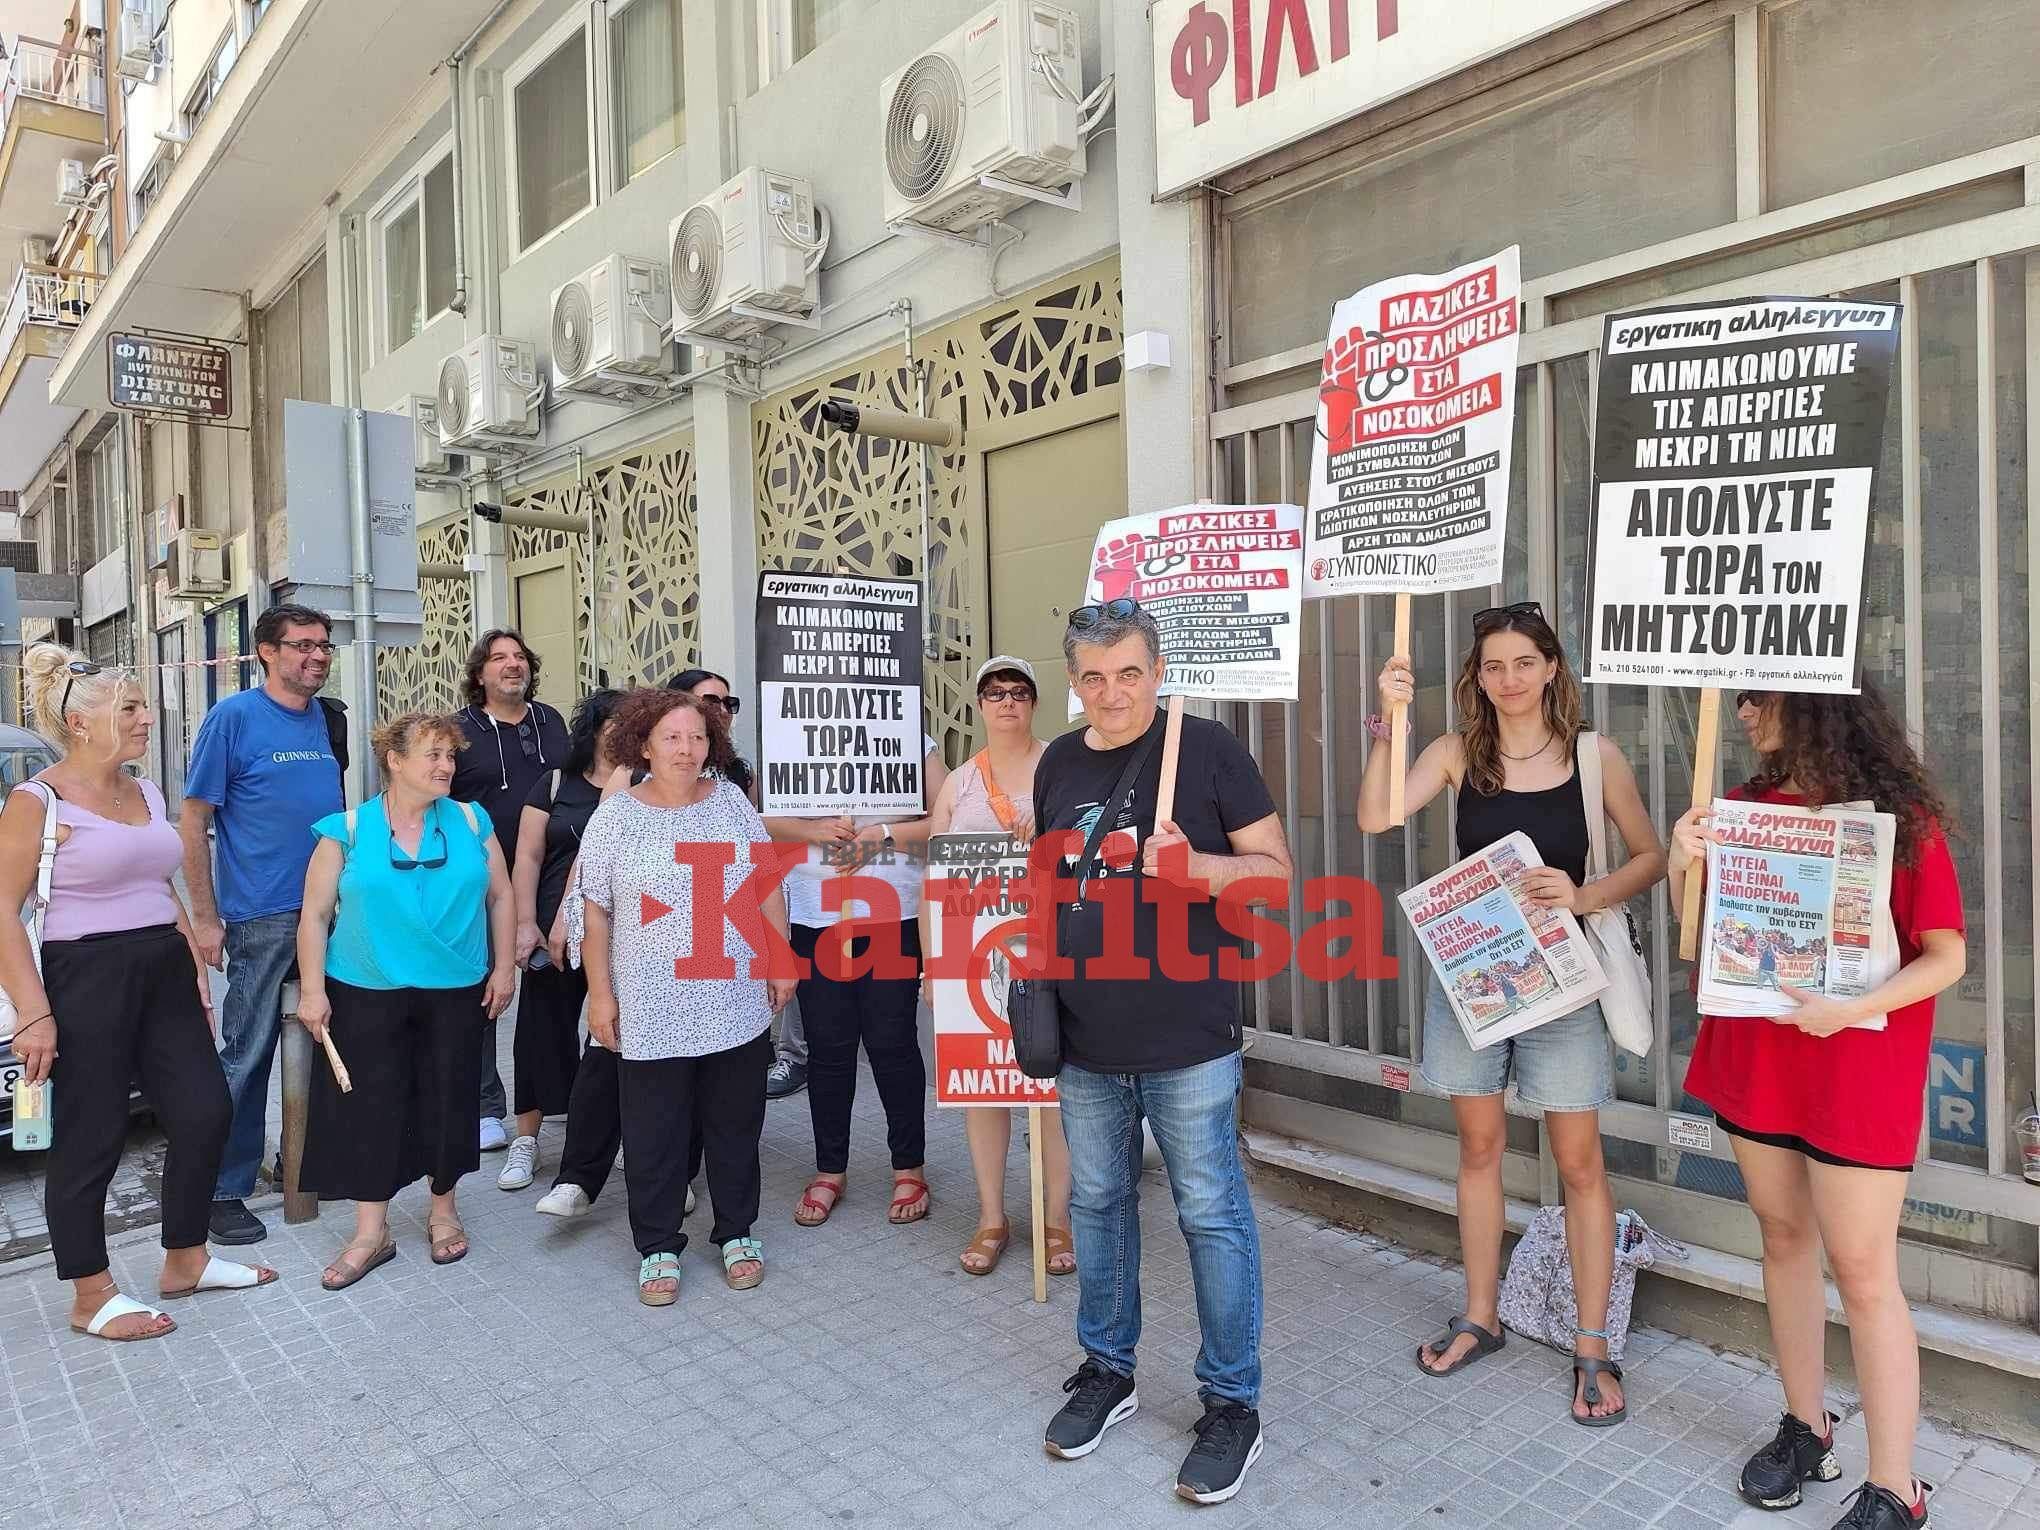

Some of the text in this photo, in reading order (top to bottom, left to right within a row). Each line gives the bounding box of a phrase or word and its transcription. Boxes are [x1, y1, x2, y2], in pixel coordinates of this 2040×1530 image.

[1388, 273, 1491, 328] ΜΑΖΙΚΕΣ
[1364, 305, 1512, 371] ΠΡΟΣΛΗΨΕΙΣ
[1616, 306, 1886, 348] εργατικη αλληλεγγυη
[116, 343, 223, 371] ΦΛΑΝΤΖΕΣ
[1630, 342, 1858, 394] ΚΛΙΜΑΚΩΝΟΥΜΕ
[128, 362, 217, 383] ΑΥΤΟΚΙΝΗΤΩΝ
[1421, 368, 1455, 394] ΣΤΑ
[120, 374, 223, 399] DIHTUNG
[129, 391, 213, 410] ZA KOLA
[1362, 383, 1493, 435] ΝΟΣΟΚΟΜΕΙΑ
[1653, 384, 1826, 430] ΤΙΣ ΑΠΕΡΓΙΕΣ
[1331, 430, 1460, 467] ΜΟΝΙΜΟΠΟΙΗΣΗ ΟΛΩΝ
[1635, 423, 1837, 469] ΜΕΧΡΙ ΤΗ ΝΙΚΗ
[1331, 447, 1452, 480] ΤΩΝ ΣΥΜΒΑΣΙΟΥΧΩΝ
[1343, 456, 1496, 498] ΑΥΞΗΣΕΙΣ ΣΤΟΥΣ ΜΙΣΘΟΥΣ
[1320, 483, 1476, 524] ΚΡΑΤΙΚΟΠΟΙΗΣΗ ΟΛΩΝ ΤΩΝ
[1320, 496, 1481, 537] ΙΔΙΩΤΙΚΩΝ ΝΟΣΗΛΕΥΤΗΡΙΩΝ
[1626, 477, 1835, 537] ΑΠΟΛΥΣΤΕ
[1168, 513, 1270, 534] ΜΑΖΙΚΕΣ
[1347, 516, 1486, 550] ΑΡΣΗ ΤΩΝ ΑΝΑΣΤΟΛΩΝ
[1144, 533, 1294, 560] ΠΡΟΣΛΗΨΕΙΣ
[1196, 556, 1233, 569] ΣΤΑ
[1328, 553, 1436, 579] ΣΥΝΤΟΝΙΣΤΙΚΟ
[1660, 543, 1822, 595] ΤΩΡΑ ΤΟΝ
[767, 578, 914, 603] εργατικη αλληλεγγυη
[1141, 572, 1280, 597] ΝΟΣΟΚΟΜΕΙΑ
[1140, 595, 1242, 611] ΜΟΠΟΙΗΣΗ ΟΛΩΝ
[1151, 603, 1233, 618] ΜΒΑΣΙΟΥΧΩΝ
[776, 606, 905, 632] ΚΛΙΜΑΚΩΝΟΥΜΕ
[1157, 614, 1284, 630] ΕΙΣ ΣΤΟΥΣ ΜΙΣΘΟΥΣ
[1601, 604, 1848, 657] ΜΗΤΣΟΤΑΚΗ
[792, 630, 892, 654] ΤΙΣ ΑΠΕΡΓΙΕΣ
[1160, 638, 1267, 651] ΝΟΣΗΛΕΥΤΗΡΙΩΝ
[1193, 631, 1229, 640] ΟΛΩΝ
[1234, 629, 1260, 638] ΤΩΝ
[783, 655, 900, 678] ΜΕΧΡΙ ΤΗ ΝΙΚΗ
[1192, 650, 1274, 662] ΑΝΑΣΤΟΛΩΝ
[1164, 668, 1215, 685] ΙΣΤΙΚΟ
[1616, 664, 1630, 673] 210
[1632, 665, 1664, 675] 5241001
[1673, 667, 1738, 679] www.ergatiki.gr
[781, 687, 903, 720] ΑΠΟΛΥΣΤΕ
[803, 725, 902, 757] ΤΩΡΑ ΤΟΝ
[272, 750, 320, 763] GUINNESS
[769, 762, 917, 795] ΜΗΤΣΟΤΑΚΗ
[1748, 813, 1836, 837] εργατικη
[1717, 826, 1835, 855] αλληλεγγυη
[1720, 853, 1768, 872] Η ΥΓΕΙΑ
[1428, 860, 1489, 898] εργατικη
[1720, 868, 1742, 883] ΔΕΝ
[1747, 871, 1784, 888] ΕΙΝΑΙ
[1414, 873, 1499, 924] αλληλεγγυη
[1719, 883, 1800, 905] ΕΜΠΟΡΕΥΜΑ
[1427, 915, 1467, 941] Η ΥΓΕΙΑ
[1434, 920, 1484, 952] ΔΕΝ ΕΙΝΑΙ
[1799, 919, 1816, 930] ΕΣΥ
[1438, 924, 1503, 962] ΕΜΠΟΡΕΥΜΑ
[947, 1069, 1057, 1095] ΑΝΑΤΡΕΨ
